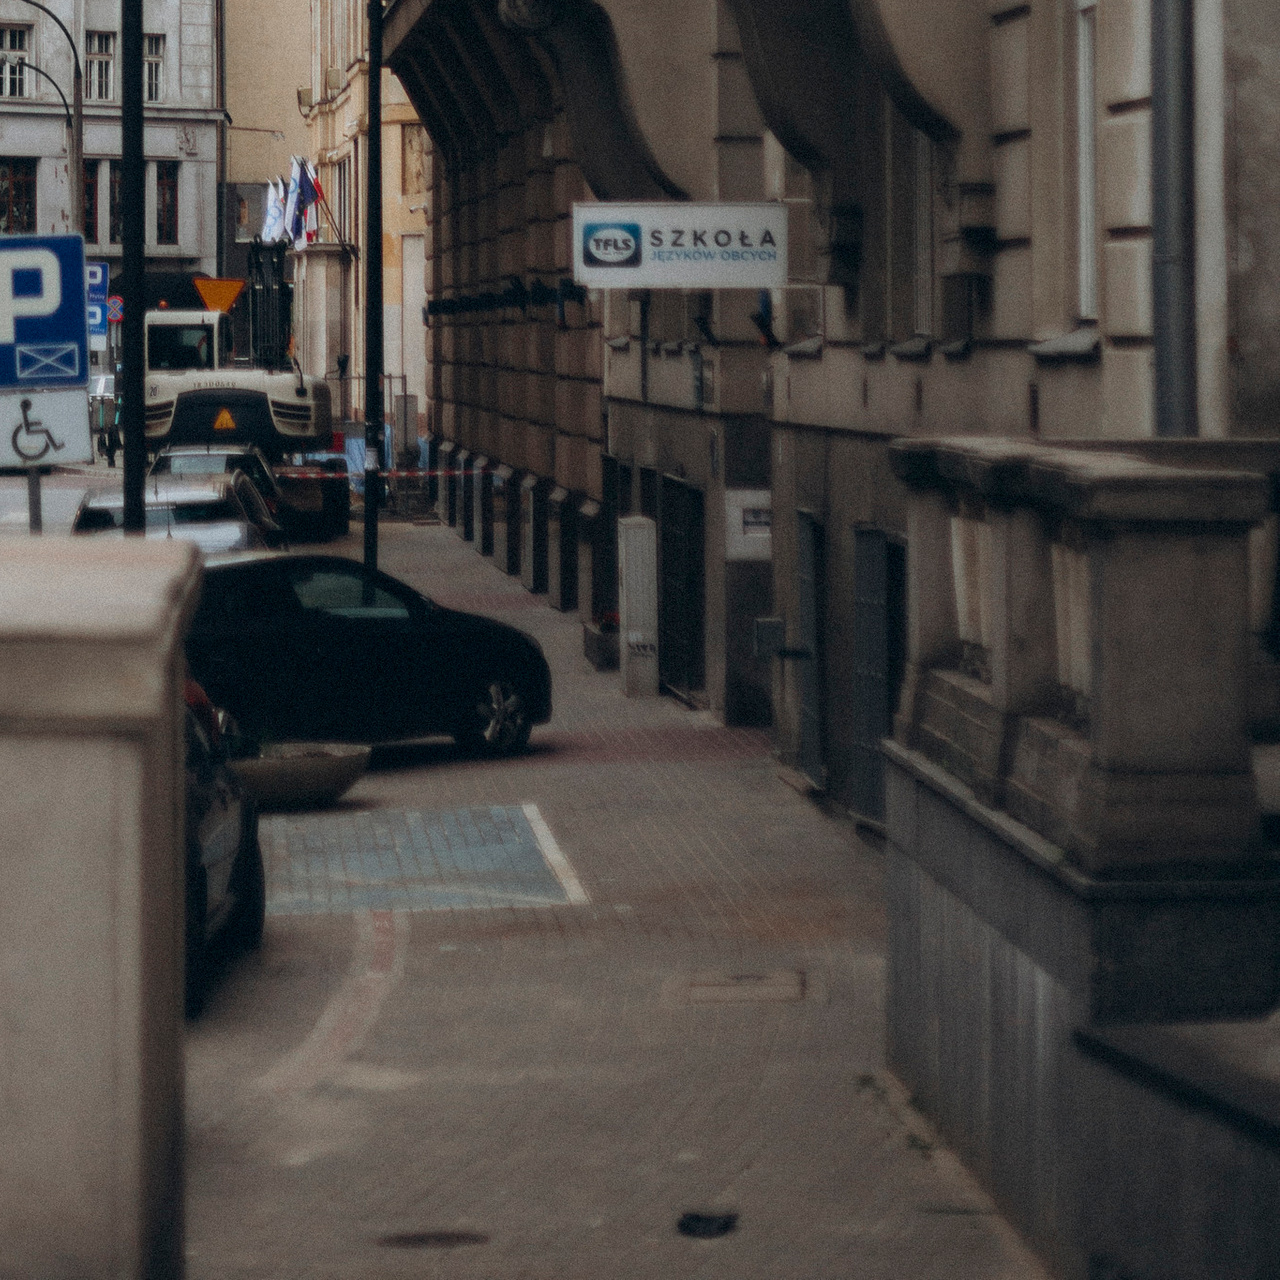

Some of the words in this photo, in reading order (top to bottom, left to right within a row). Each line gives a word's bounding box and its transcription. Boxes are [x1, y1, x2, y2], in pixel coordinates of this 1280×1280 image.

[593, 238, 632, 252] TFLS
[650, 229, 776, 247] SZKOŁA
[651, 248, 716, 262] JĘZYKÓW
[721, 250, 777, 261] OBCYCH
